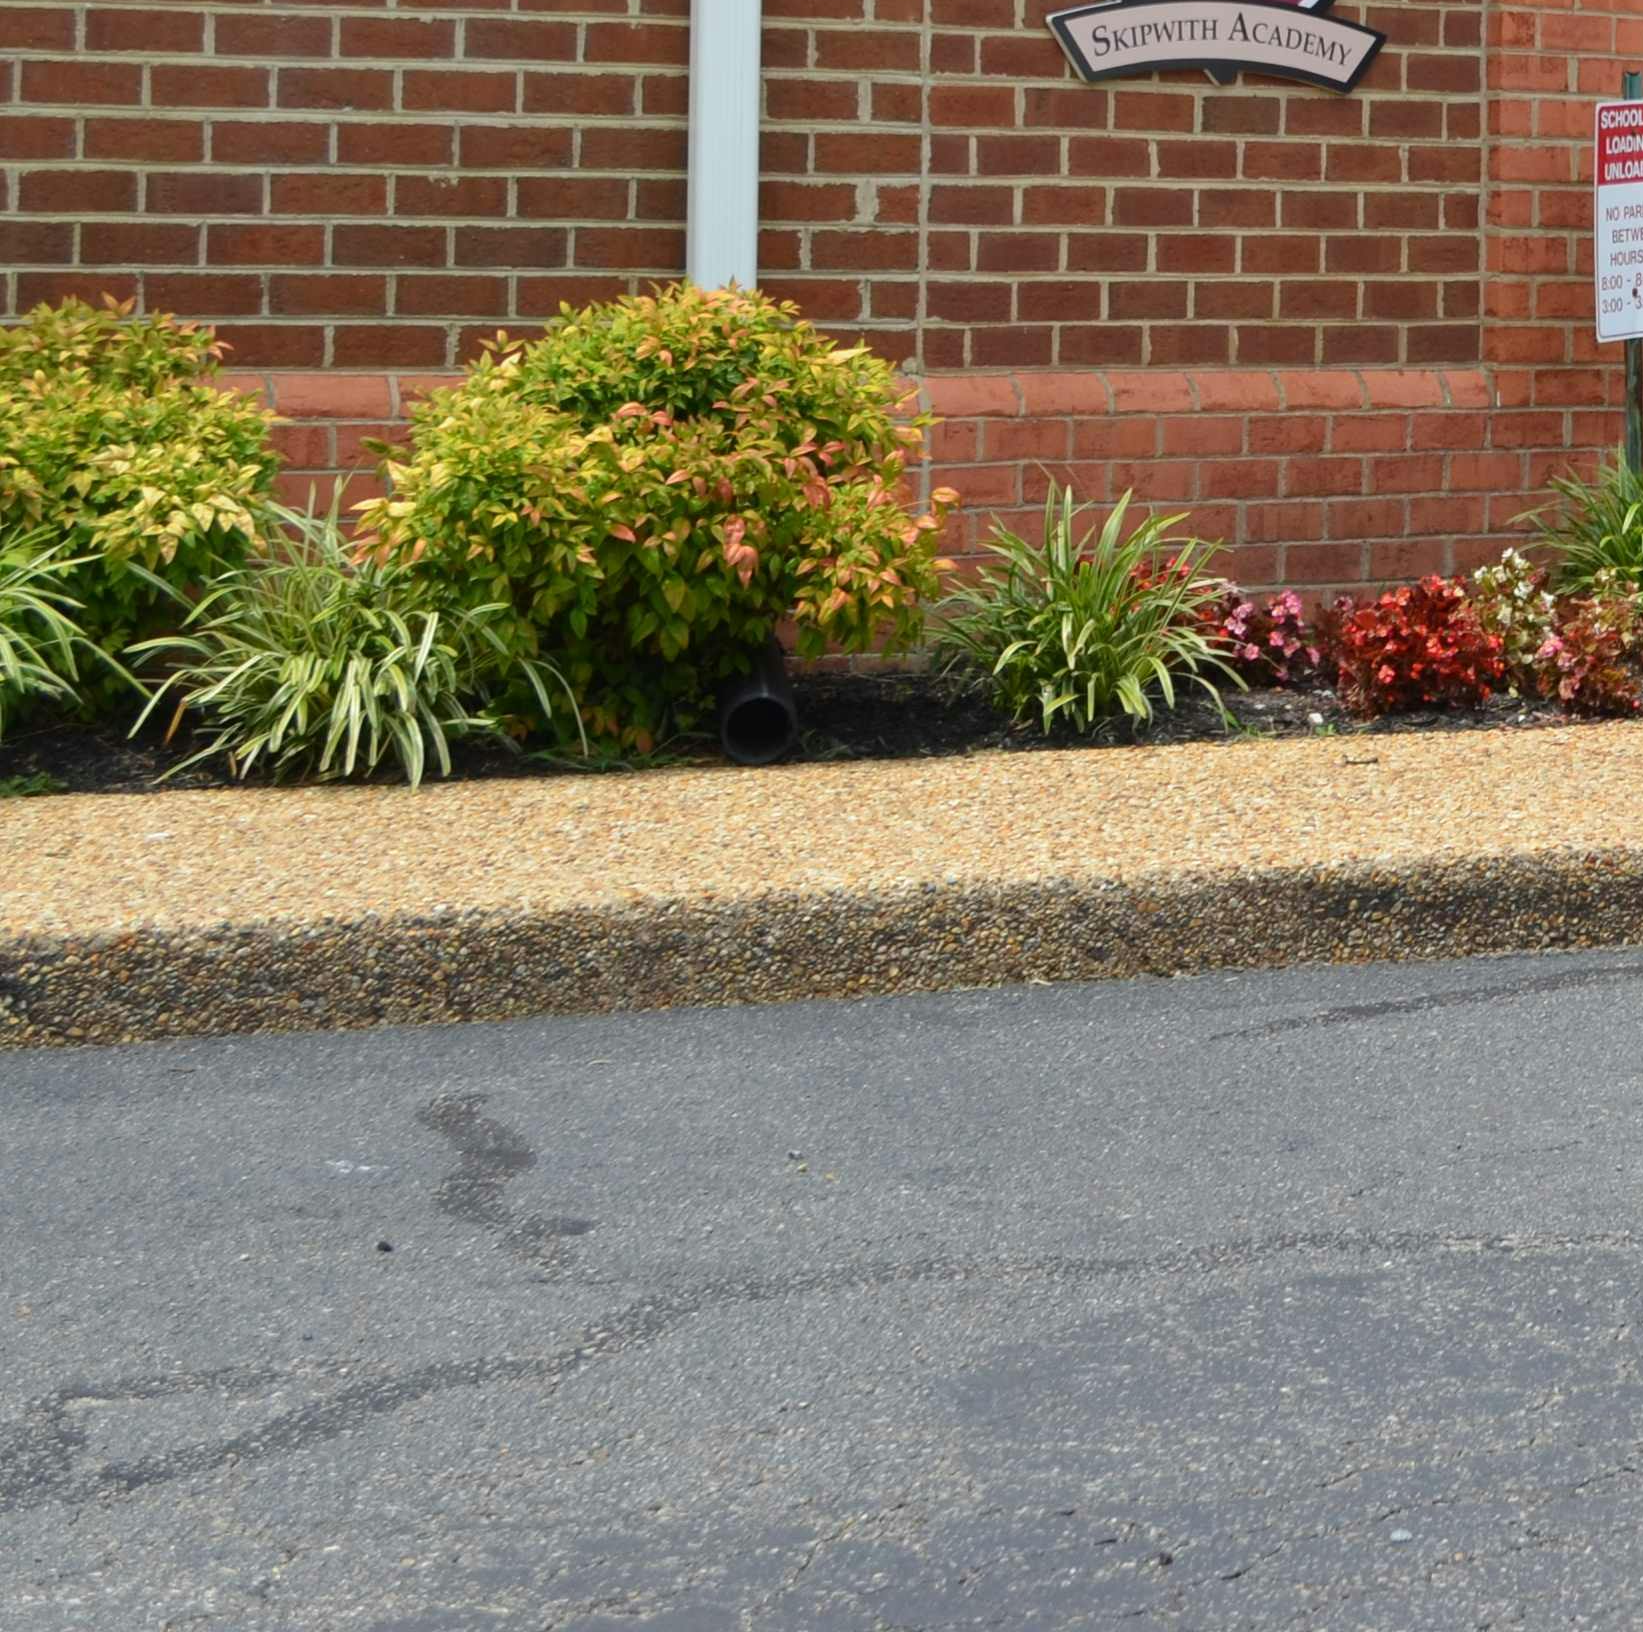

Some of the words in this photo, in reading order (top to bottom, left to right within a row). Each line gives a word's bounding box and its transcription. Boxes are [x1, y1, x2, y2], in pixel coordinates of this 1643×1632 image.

[1091, 19, 1219, 57] SKIPWITH
[1228, 12, 1353, 66] ACADEMY
[1606, 206, 1620, 222] NO
[1601, 274, 1623, 291] 8:00
[1602, 297, 1623, 314] 3:00
